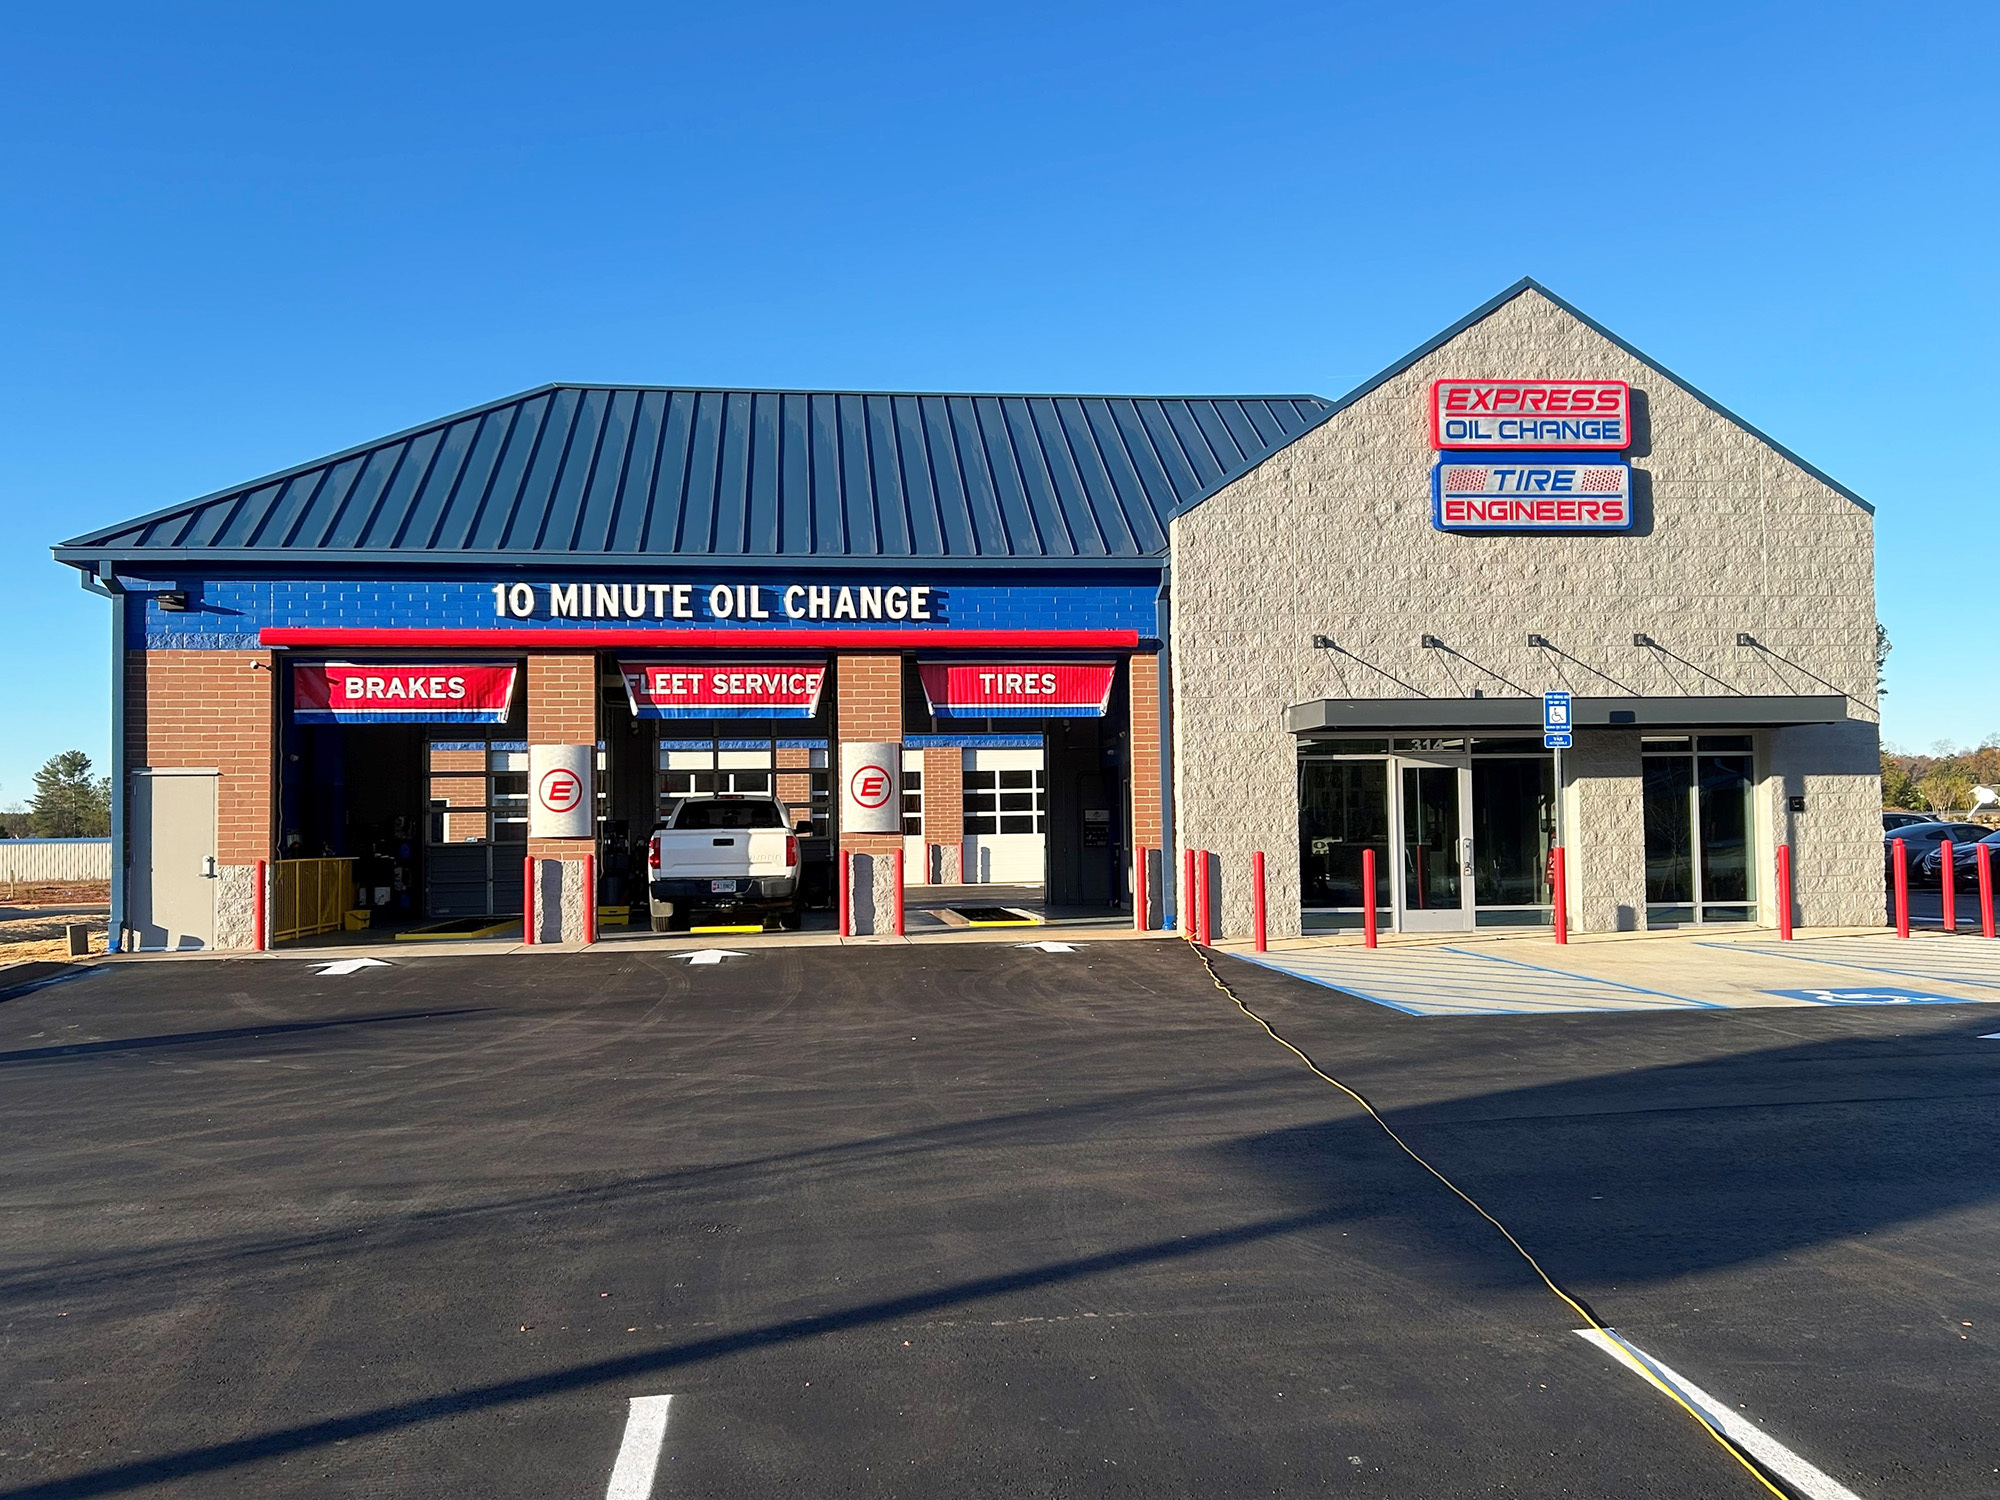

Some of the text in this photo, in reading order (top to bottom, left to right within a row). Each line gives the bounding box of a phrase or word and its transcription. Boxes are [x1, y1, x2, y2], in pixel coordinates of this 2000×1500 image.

[1445, 388, 1622, 411] EXPRESS
[1445, 420, 1621, 440] OIL CHANGE
[1493, 469, 1577, 492] TIRE
[1445, 500, 1625, 521] ENGINEERS
[491, 582, 931, 620] 10 MINUTE OIL CHANGE
[345, 676, 466, 699] BRAKES
[627, 673, 821, 695] FLEET SERVICE
[979, 673, 1057, 695] TIRES
[1411, 738, 1445, 751] 314
[548, 780, 575, 801] E
[860, 776, 885, 797] E
